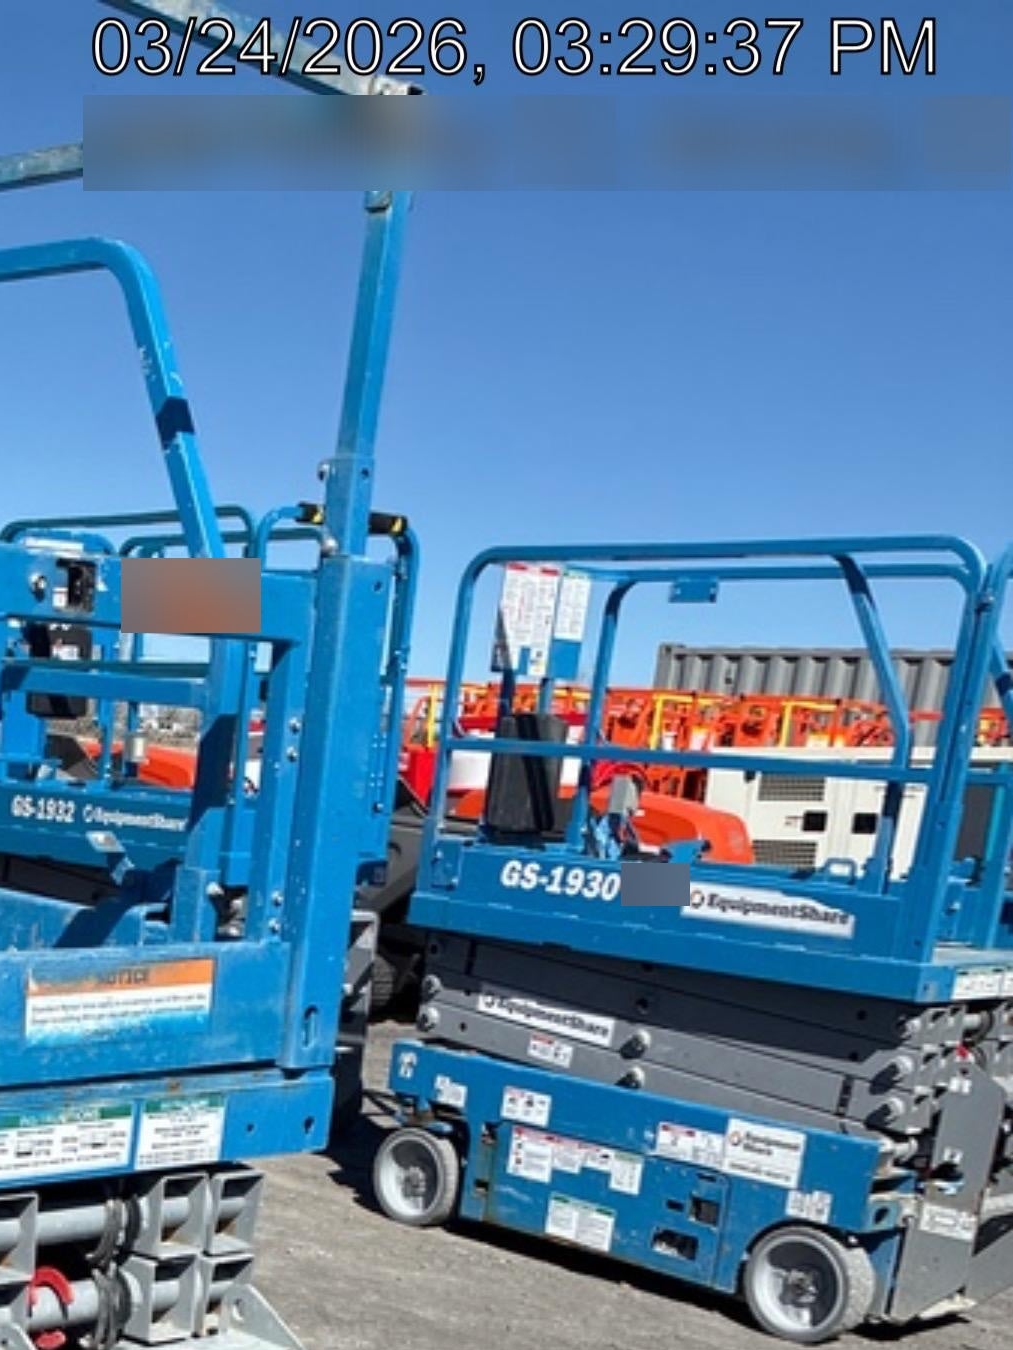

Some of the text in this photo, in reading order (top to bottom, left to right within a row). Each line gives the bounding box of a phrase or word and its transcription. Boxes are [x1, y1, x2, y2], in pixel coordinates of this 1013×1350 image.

[11, 794, 75, 824] GS-1932
[500, 860, 621, 901] GS-1930
[707, 892, 851, 926] EquipmentShare
